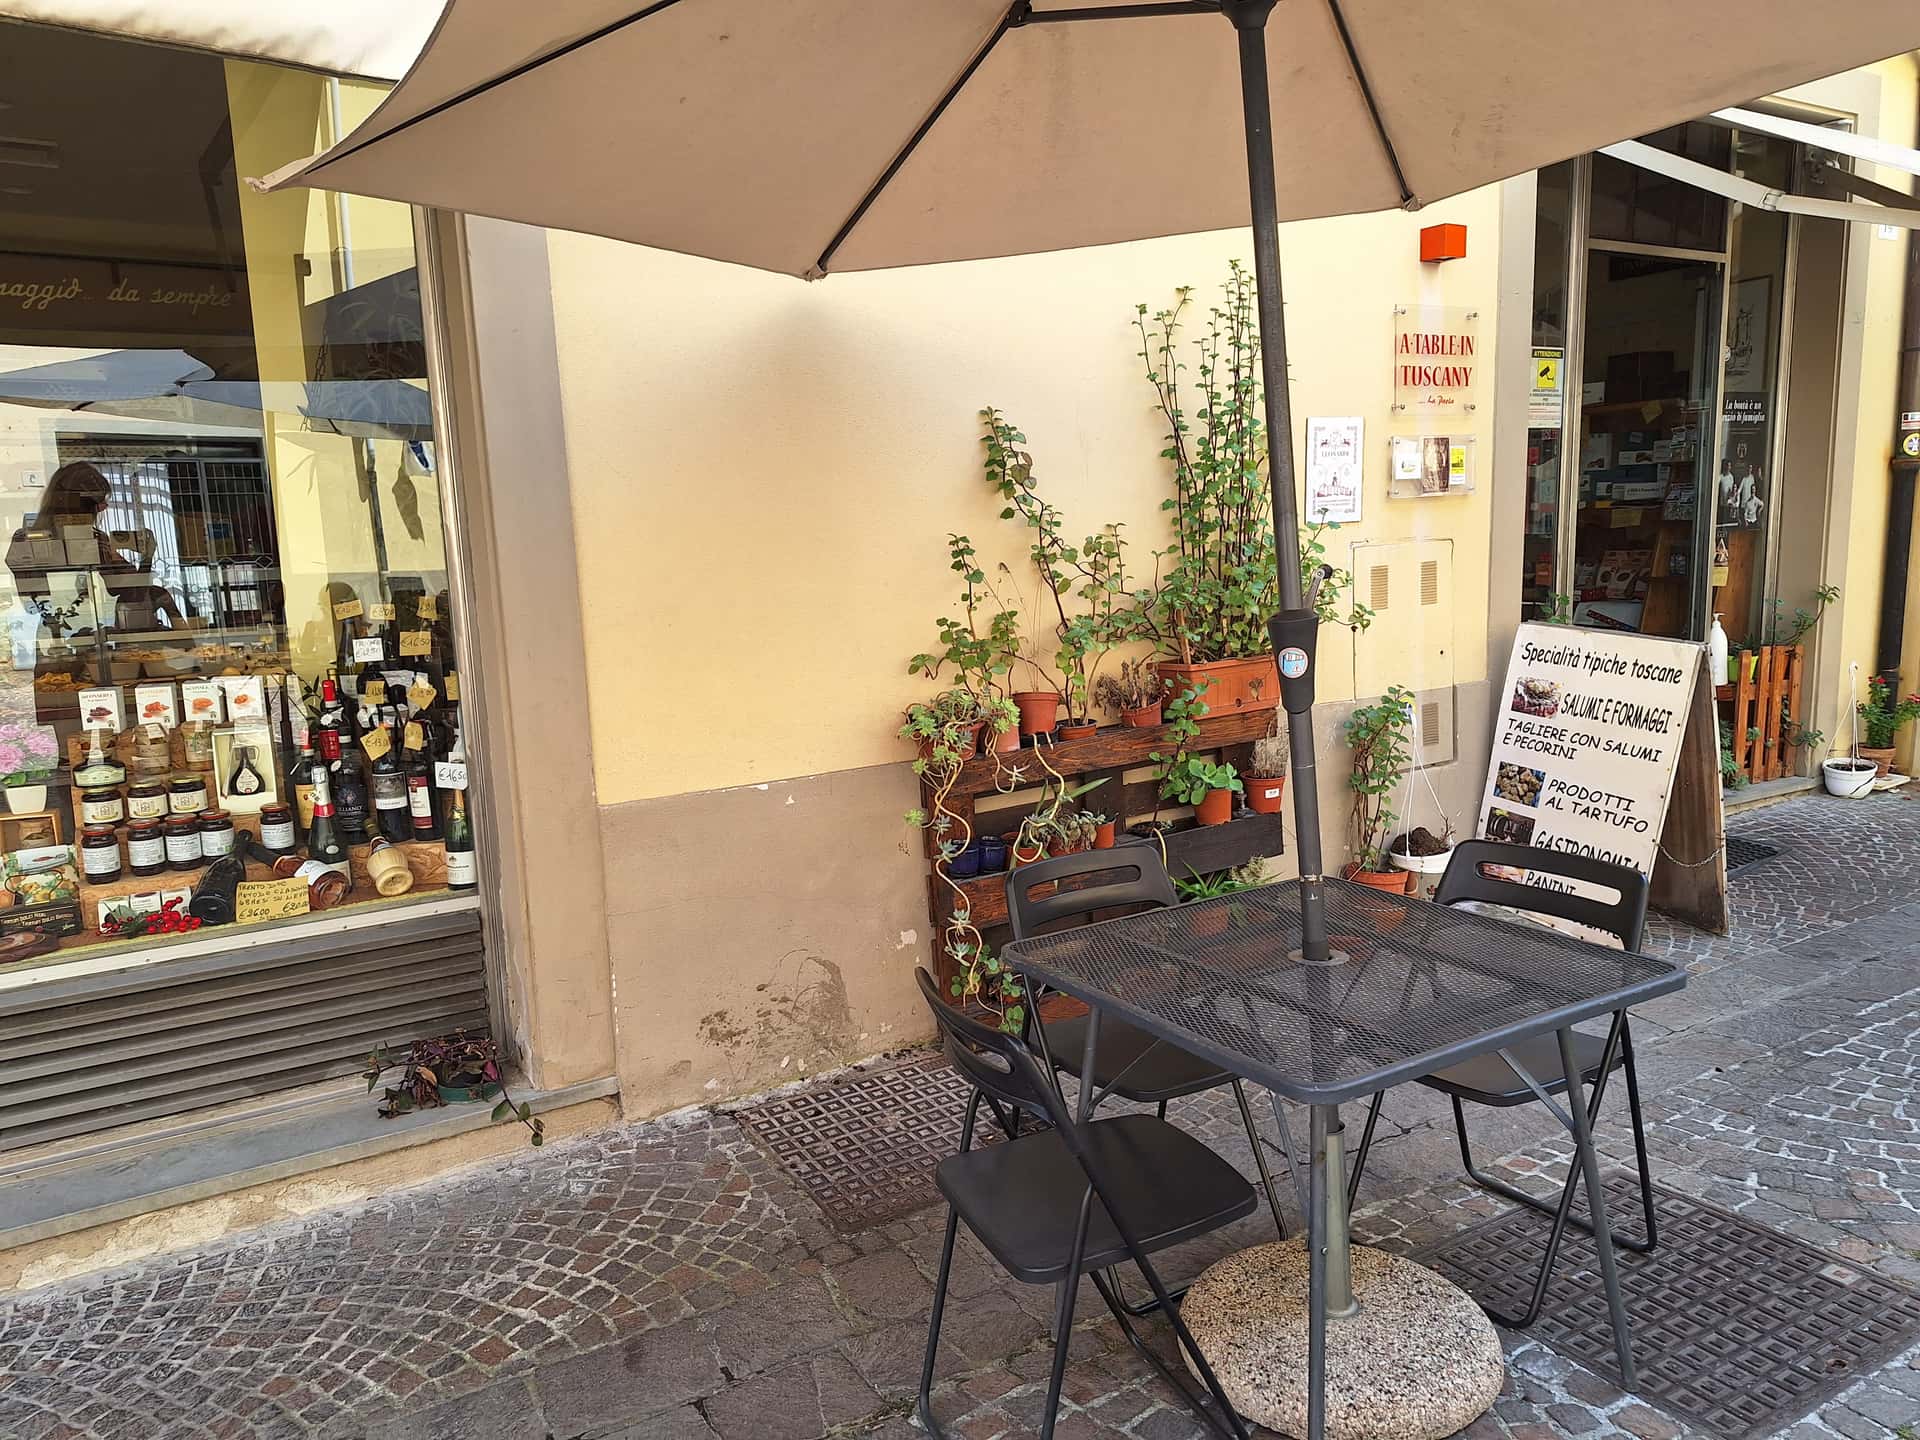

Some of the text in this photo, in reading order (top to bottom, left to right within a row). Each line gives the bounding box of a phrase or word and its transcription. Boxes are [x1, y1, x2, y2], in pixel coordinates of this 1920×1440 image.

[109, 278, 140, 302] da
[151, 284, 232, 316] sempre
[1400, 365, 1472, 387] TUSCANY
[1521, 641, 1683, 685] Specialità tipiche toscane
[1560, 692, 1672, 735] SALUMI E FORMAGGI
[1502, 732, 1577, 760] E PECORINI
[1508, 718, 1662, 763] TAGLIERE CON SALUMI
[1547, 778, 1636, 812] PRODOTTI
[1545, 796, 1649, 833] AL TARTUFO
